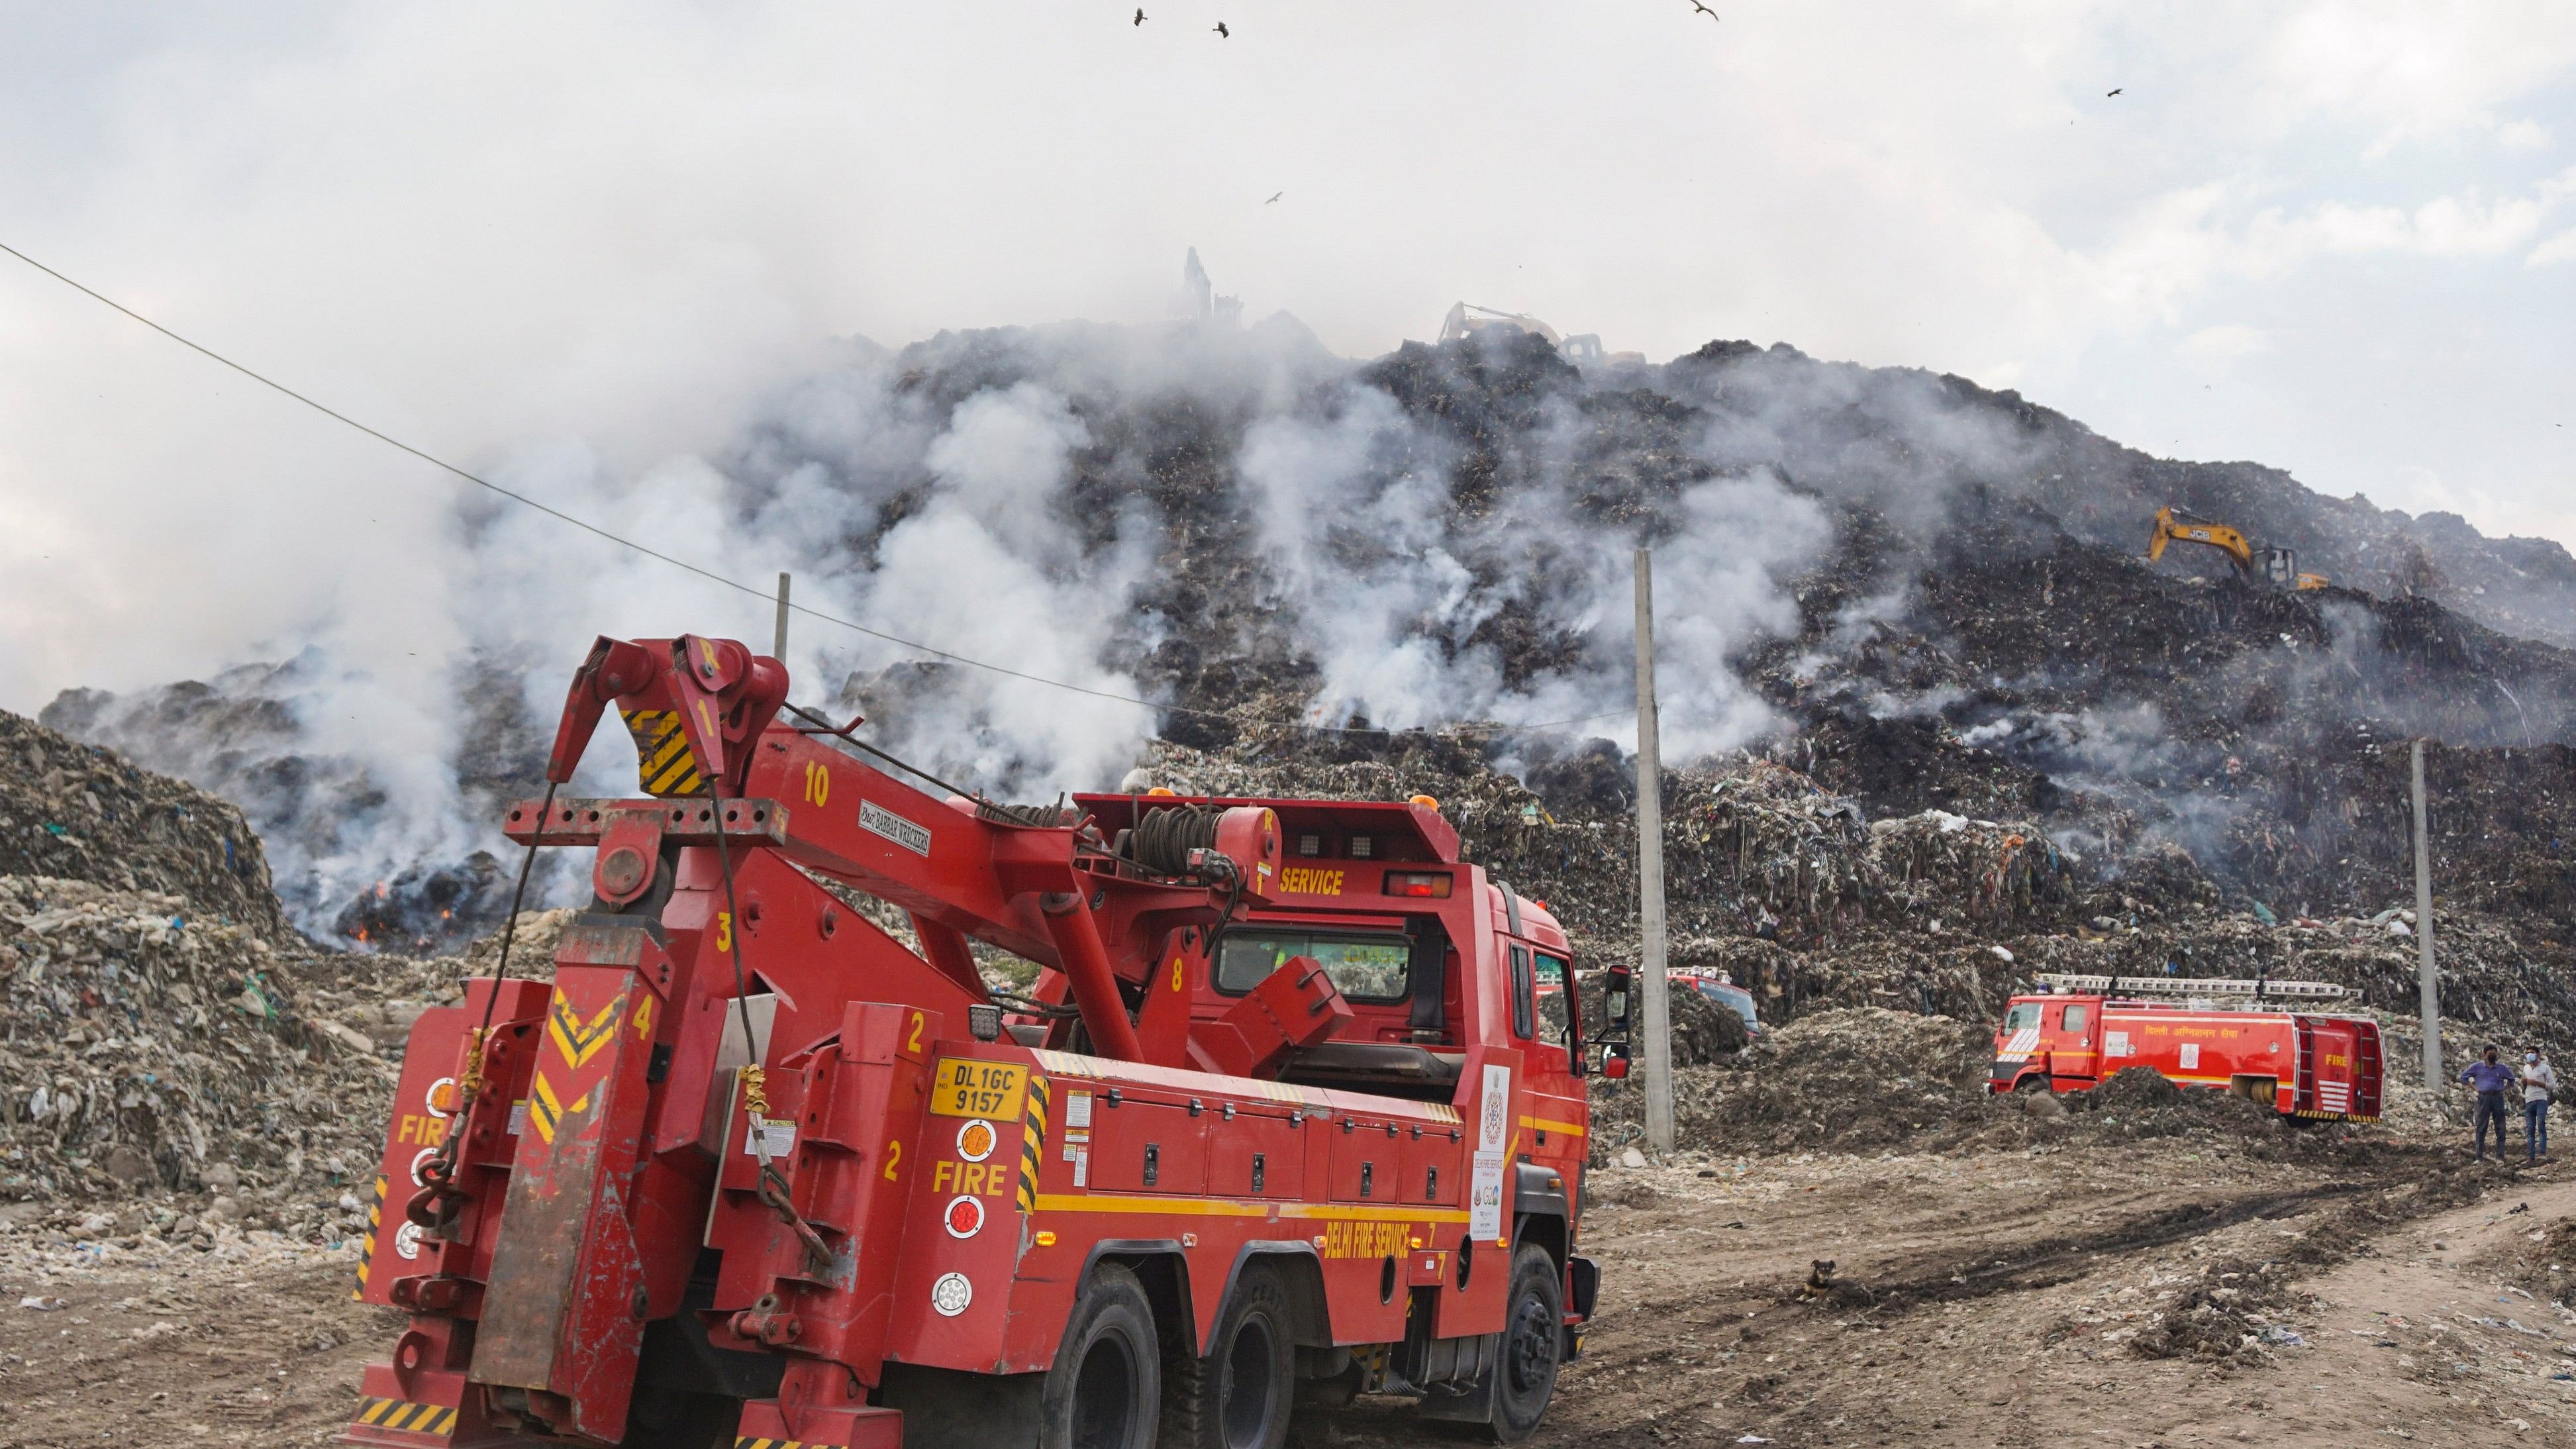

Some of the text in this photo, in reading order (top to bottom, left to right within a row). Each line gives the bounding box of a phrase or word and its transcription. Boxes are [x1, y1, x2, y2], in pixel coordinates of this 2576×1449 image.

[699, 638, 721, 670] R
[697, 699, 715, 736] 1
[805, 760, 829, 807] 10
[875, 812, 897, 838] BABBAR
[899, 822, 928, 852] WRECKERS
[1264, 810, 1273, 830] R
[1279, 867, 1344, 895] SERVICE
[717, 912, 732, 952] 3
[1171, 957, 1183, 993] 8
[632, 995, 653, 1040] 4
[907, 1011, 924, 1054] 2
[2146, 1024, 2168, 1036] दिल्ली
[2325, 1054, 2347, 1067] FIRE
[956, 1090, 1004, 1114] 9157
[397, 1114, 446, 1147] FIR
[884, 1140, 901, 1181] 2
[933, 1160, 1007, 1197] FIRE
[1324, 1221, 1411, 1259] DELHI FIRE SERVICE
[1428, 1222, 1436, 1248] 7
[1438, 1252, 1446, 1280] 7
